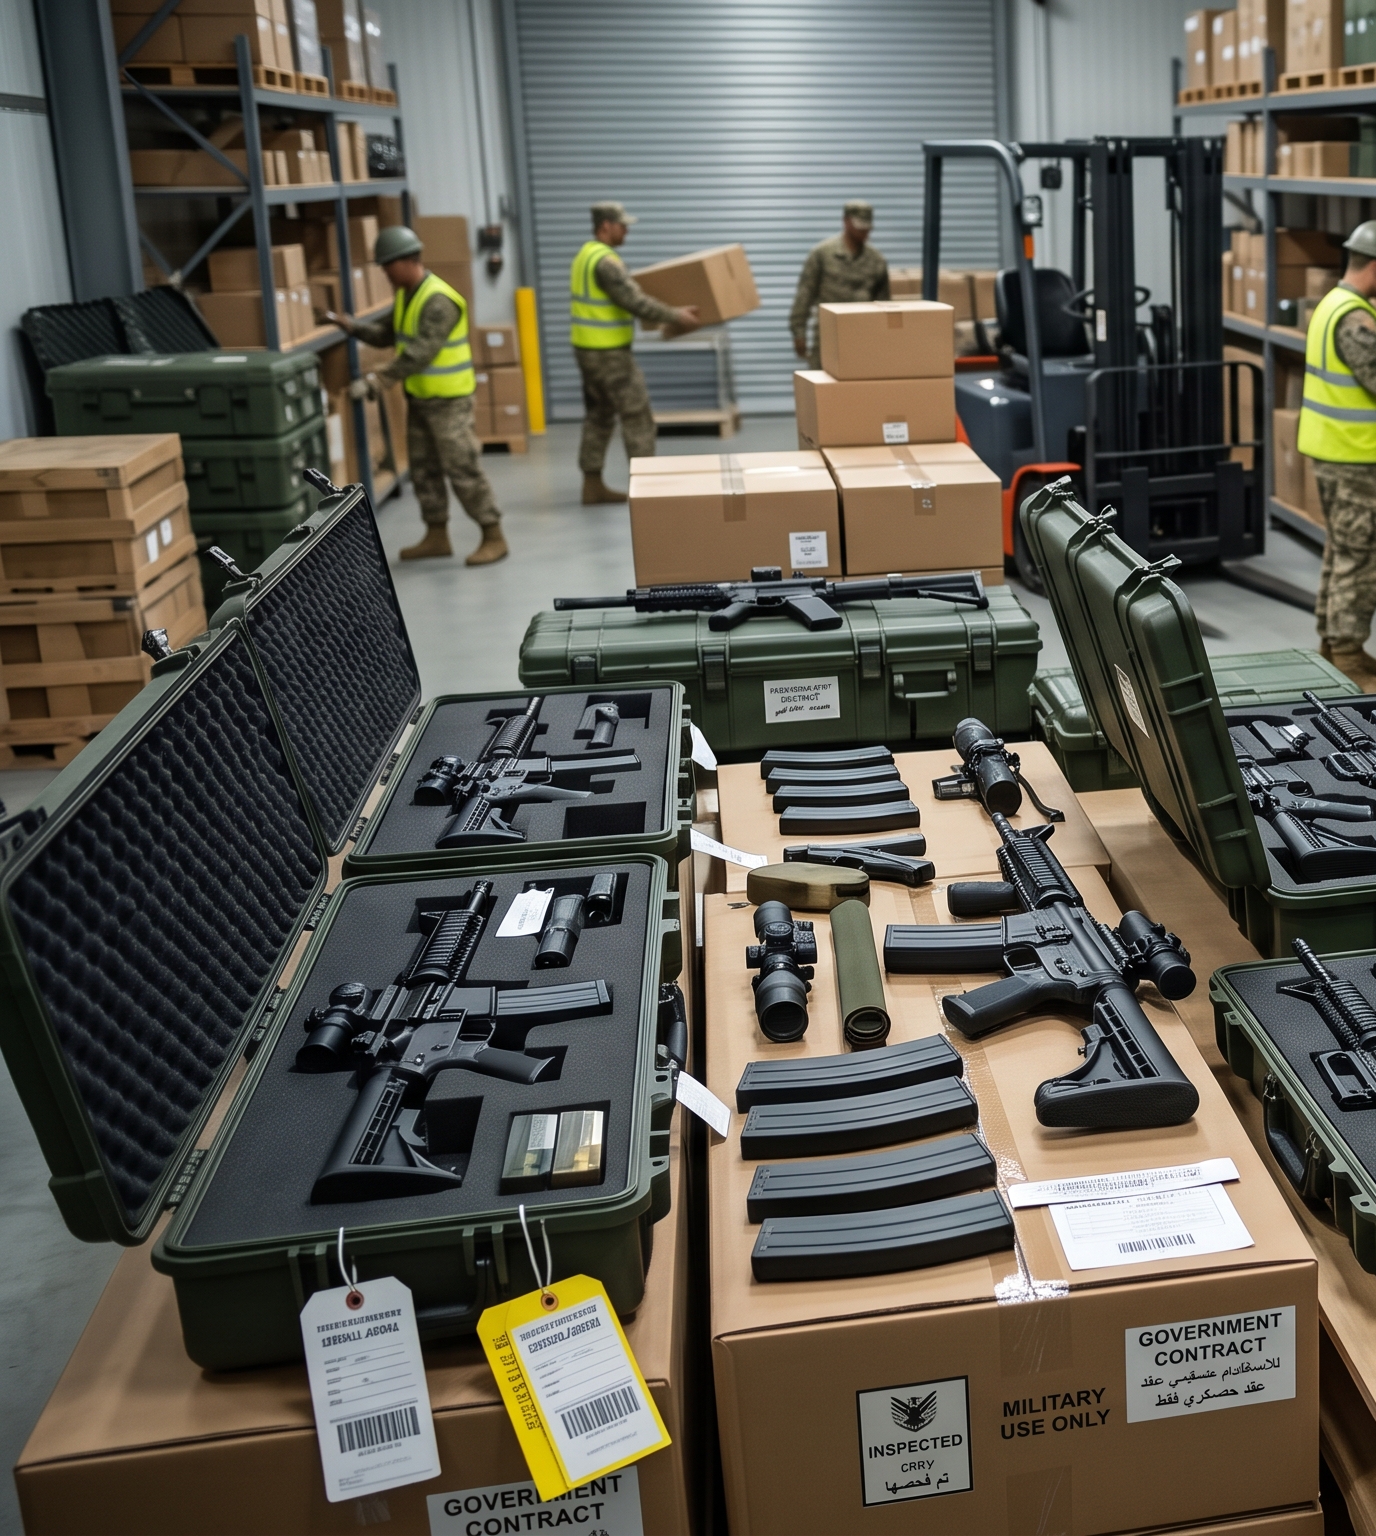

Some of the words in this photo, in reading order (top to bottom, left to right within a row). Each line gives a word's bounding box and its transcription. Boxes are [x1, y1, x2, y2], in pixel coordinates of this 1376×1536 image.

[1138, 1312, 1282, 1347] GOVERNMENT
[1154, 1336, 1267, 1366] CONTRACT
[1003, 1387, 1106, 1418] MILITARY
[1154, 1391, 1179, 1407] فقط
[1000, 1418, 1045, 1440] USE
[1051, 1408, 1111, 1432] ONLY
[868, 1434, 963, 1459] INSPECTED
[936, 1472, 950, 1490] تم
[465, 1502, 605, 1536] CONTRACT
